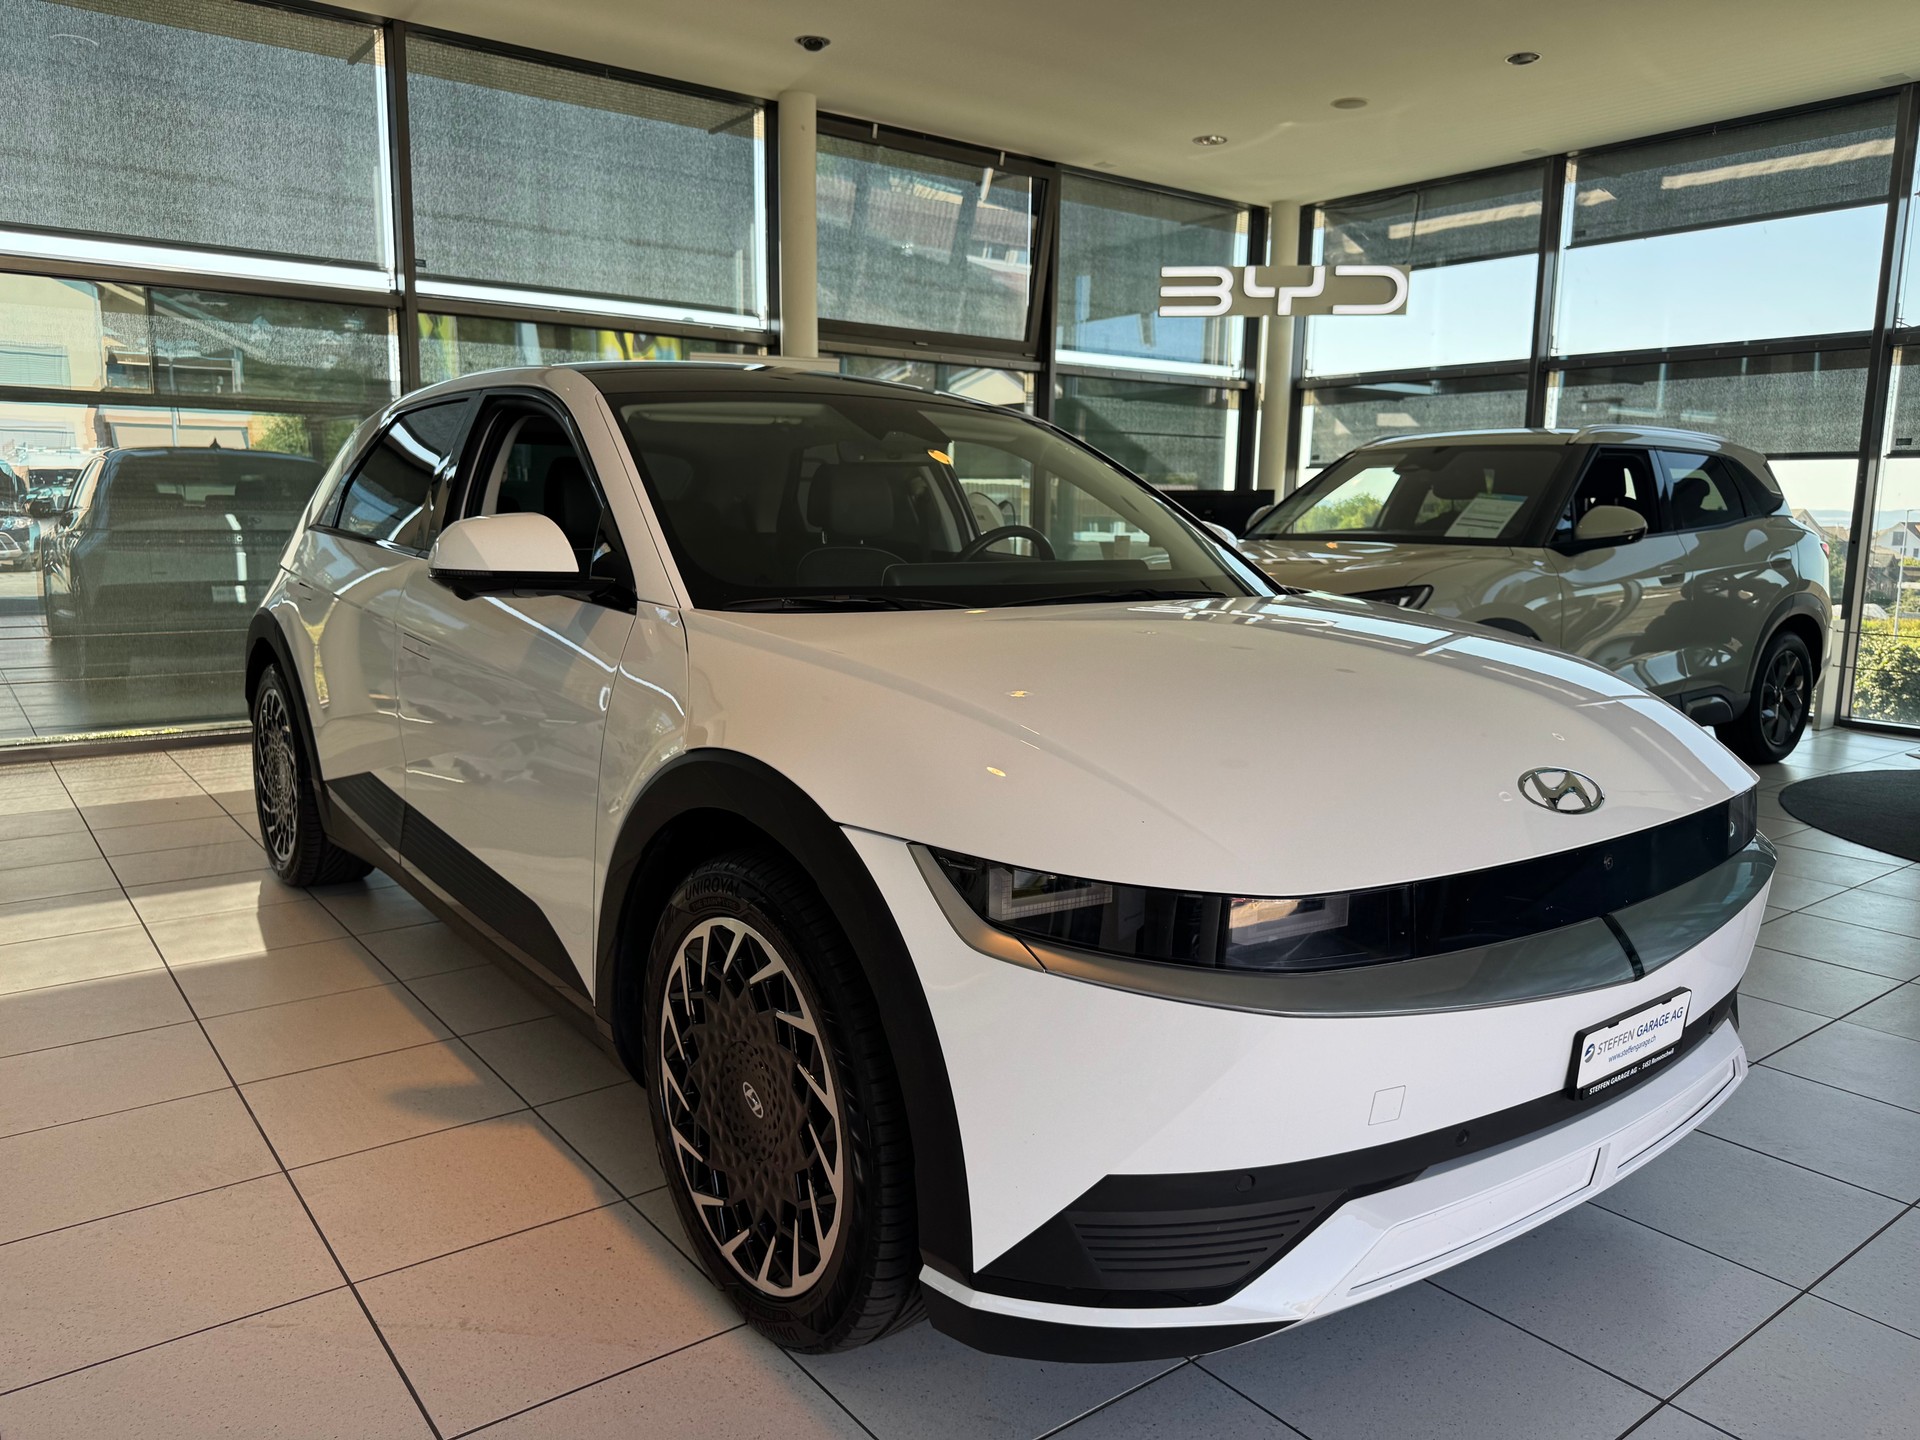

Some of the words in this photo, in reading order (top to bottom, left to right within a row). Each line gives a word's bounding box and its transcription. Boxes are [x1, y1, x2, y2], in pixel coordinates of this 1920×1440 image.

[1159, 265, 1408, 317] BYD
[1597, 1029, 1635, 1055] STEFFEN
[1636, 1012, 1670, 1037] GARAGE
[1670, 1007, 1684, 1022] AG
[1608, 1034, 1657, 1062] www.steffengarage.ch
[1589, 1079, 1611, 1095] STEFFEN
[1610, 1069, 1631, 1085] GARAGE
[1630, 1066, 1638, 1075] AG
